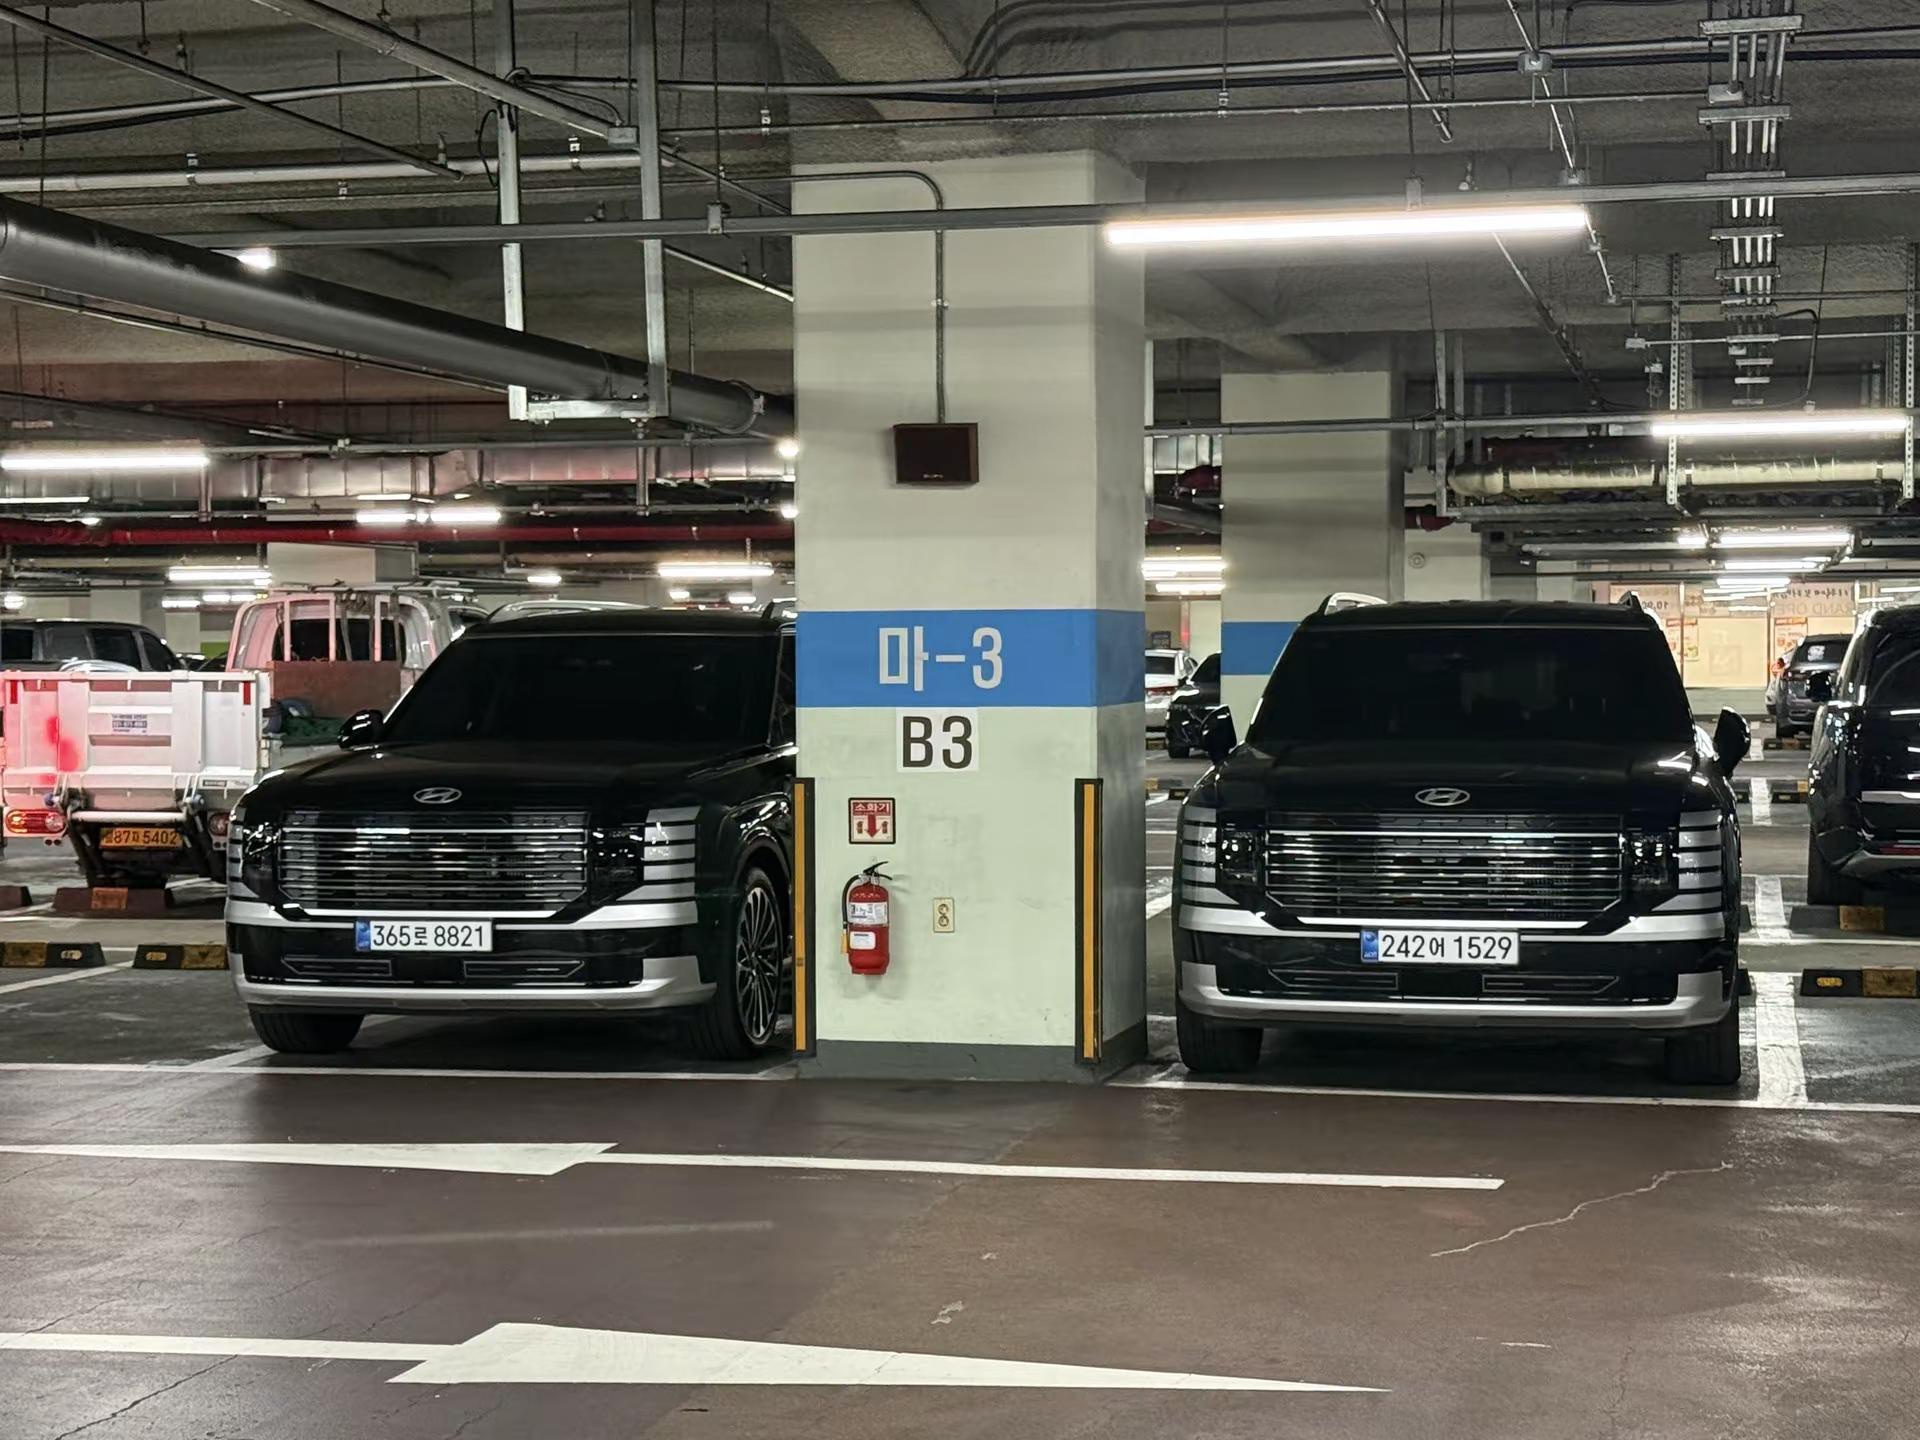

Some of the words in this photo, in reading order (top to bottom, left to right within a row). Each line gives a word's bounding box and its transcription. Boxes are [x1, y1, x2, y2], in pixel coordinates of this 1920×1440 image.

[879, 625, 1003, 692] 마-3
[902, 715, 973, 769] B3
[854, 803, 890, 813] 소화기
[373, 925, 428, 947] 365로
[434, 925, 483, 947] 8821
[1382, 934, 1446, 958] 242어
[1453, 936, 1512, 960] 1529
